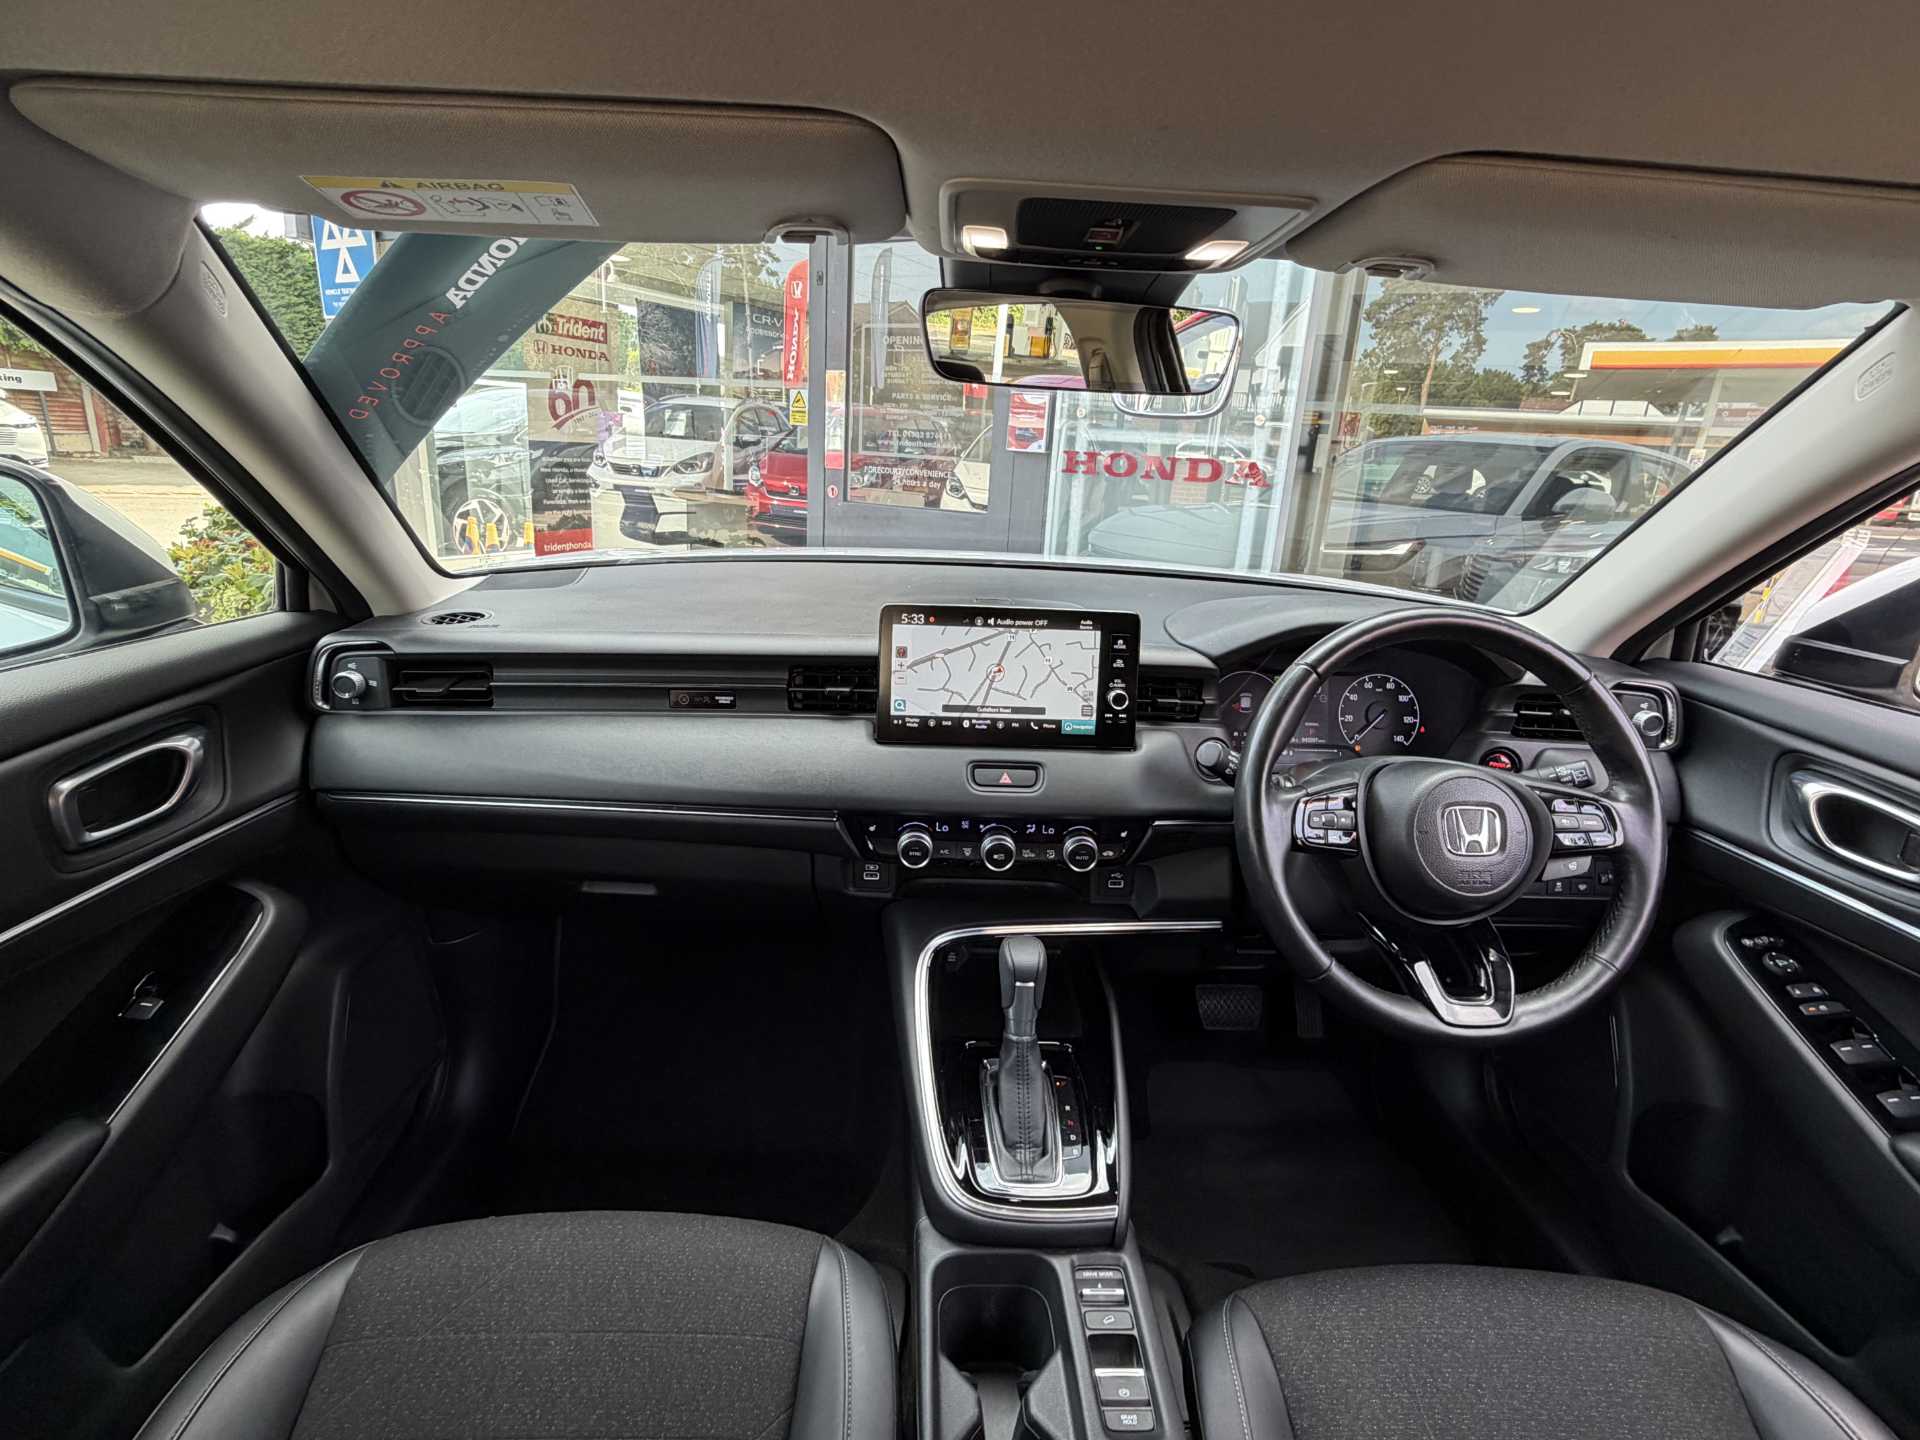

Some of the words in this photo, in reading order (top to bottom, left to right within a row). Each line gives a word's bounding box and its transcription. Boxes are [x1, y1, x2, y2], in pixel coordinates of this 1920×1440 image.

[416, 181, 505, 192] AIRBAG
[557, 318, 605, 341] Trident
[550, 343, 610, 362] HONDA
[1061, 448, 1273, 490] HONDA
[929, 481, 941, 489] day
[901, 613, 925, 625] 5:33
[997, 618, 1014, 626] Audio
[1364, 681, 1373, 690] 60
[1386, 681, 1395, 690] 80
[1349, 693, 1358, 702] 40
[1398, 694, 1409, 703] 100
[1344, 714, 1354, 723] 20
[1403, 715, 1414, 724] 120
[1394, 734, 1405, 742] 140
[935, 821, 949, 832] Lo
[1042, 825, 1055, 835] Lo
